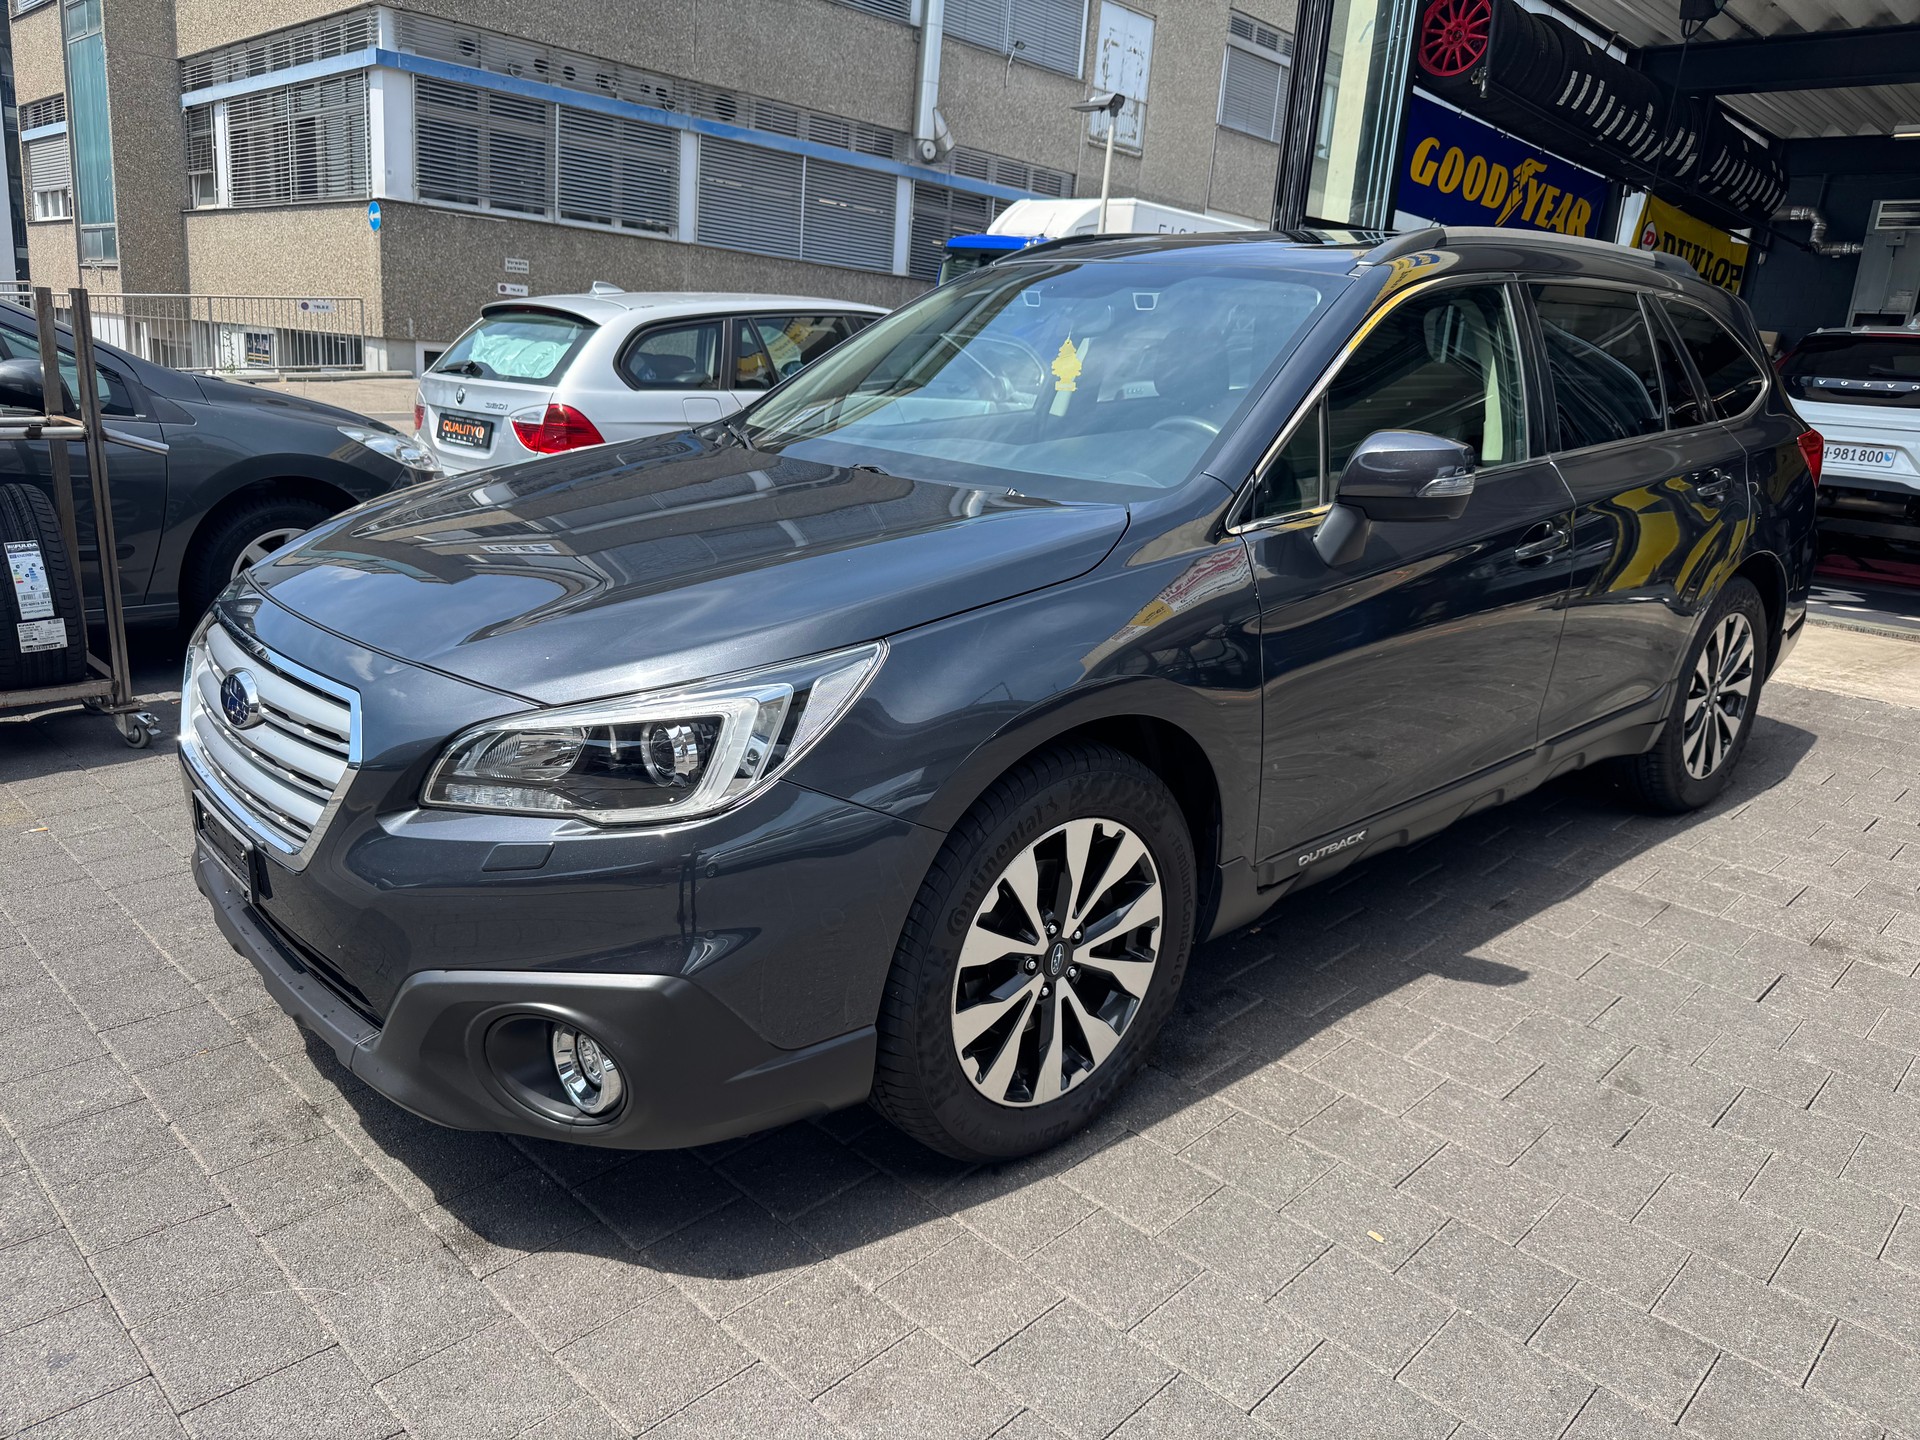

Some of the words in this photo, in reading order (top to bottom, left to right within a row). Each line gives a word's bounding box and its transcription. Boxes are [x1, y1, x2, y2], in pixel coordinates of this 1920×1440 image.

[1410, 137, 1592, 237] GOODYEAR
[1663, 231, 1744, 290] DUNLOP
[1818, 379, 1920, 391] VOLVO
[947, 804, 1044, 937] Continental
[1298, 830, 1366, 866] OUTBACK
